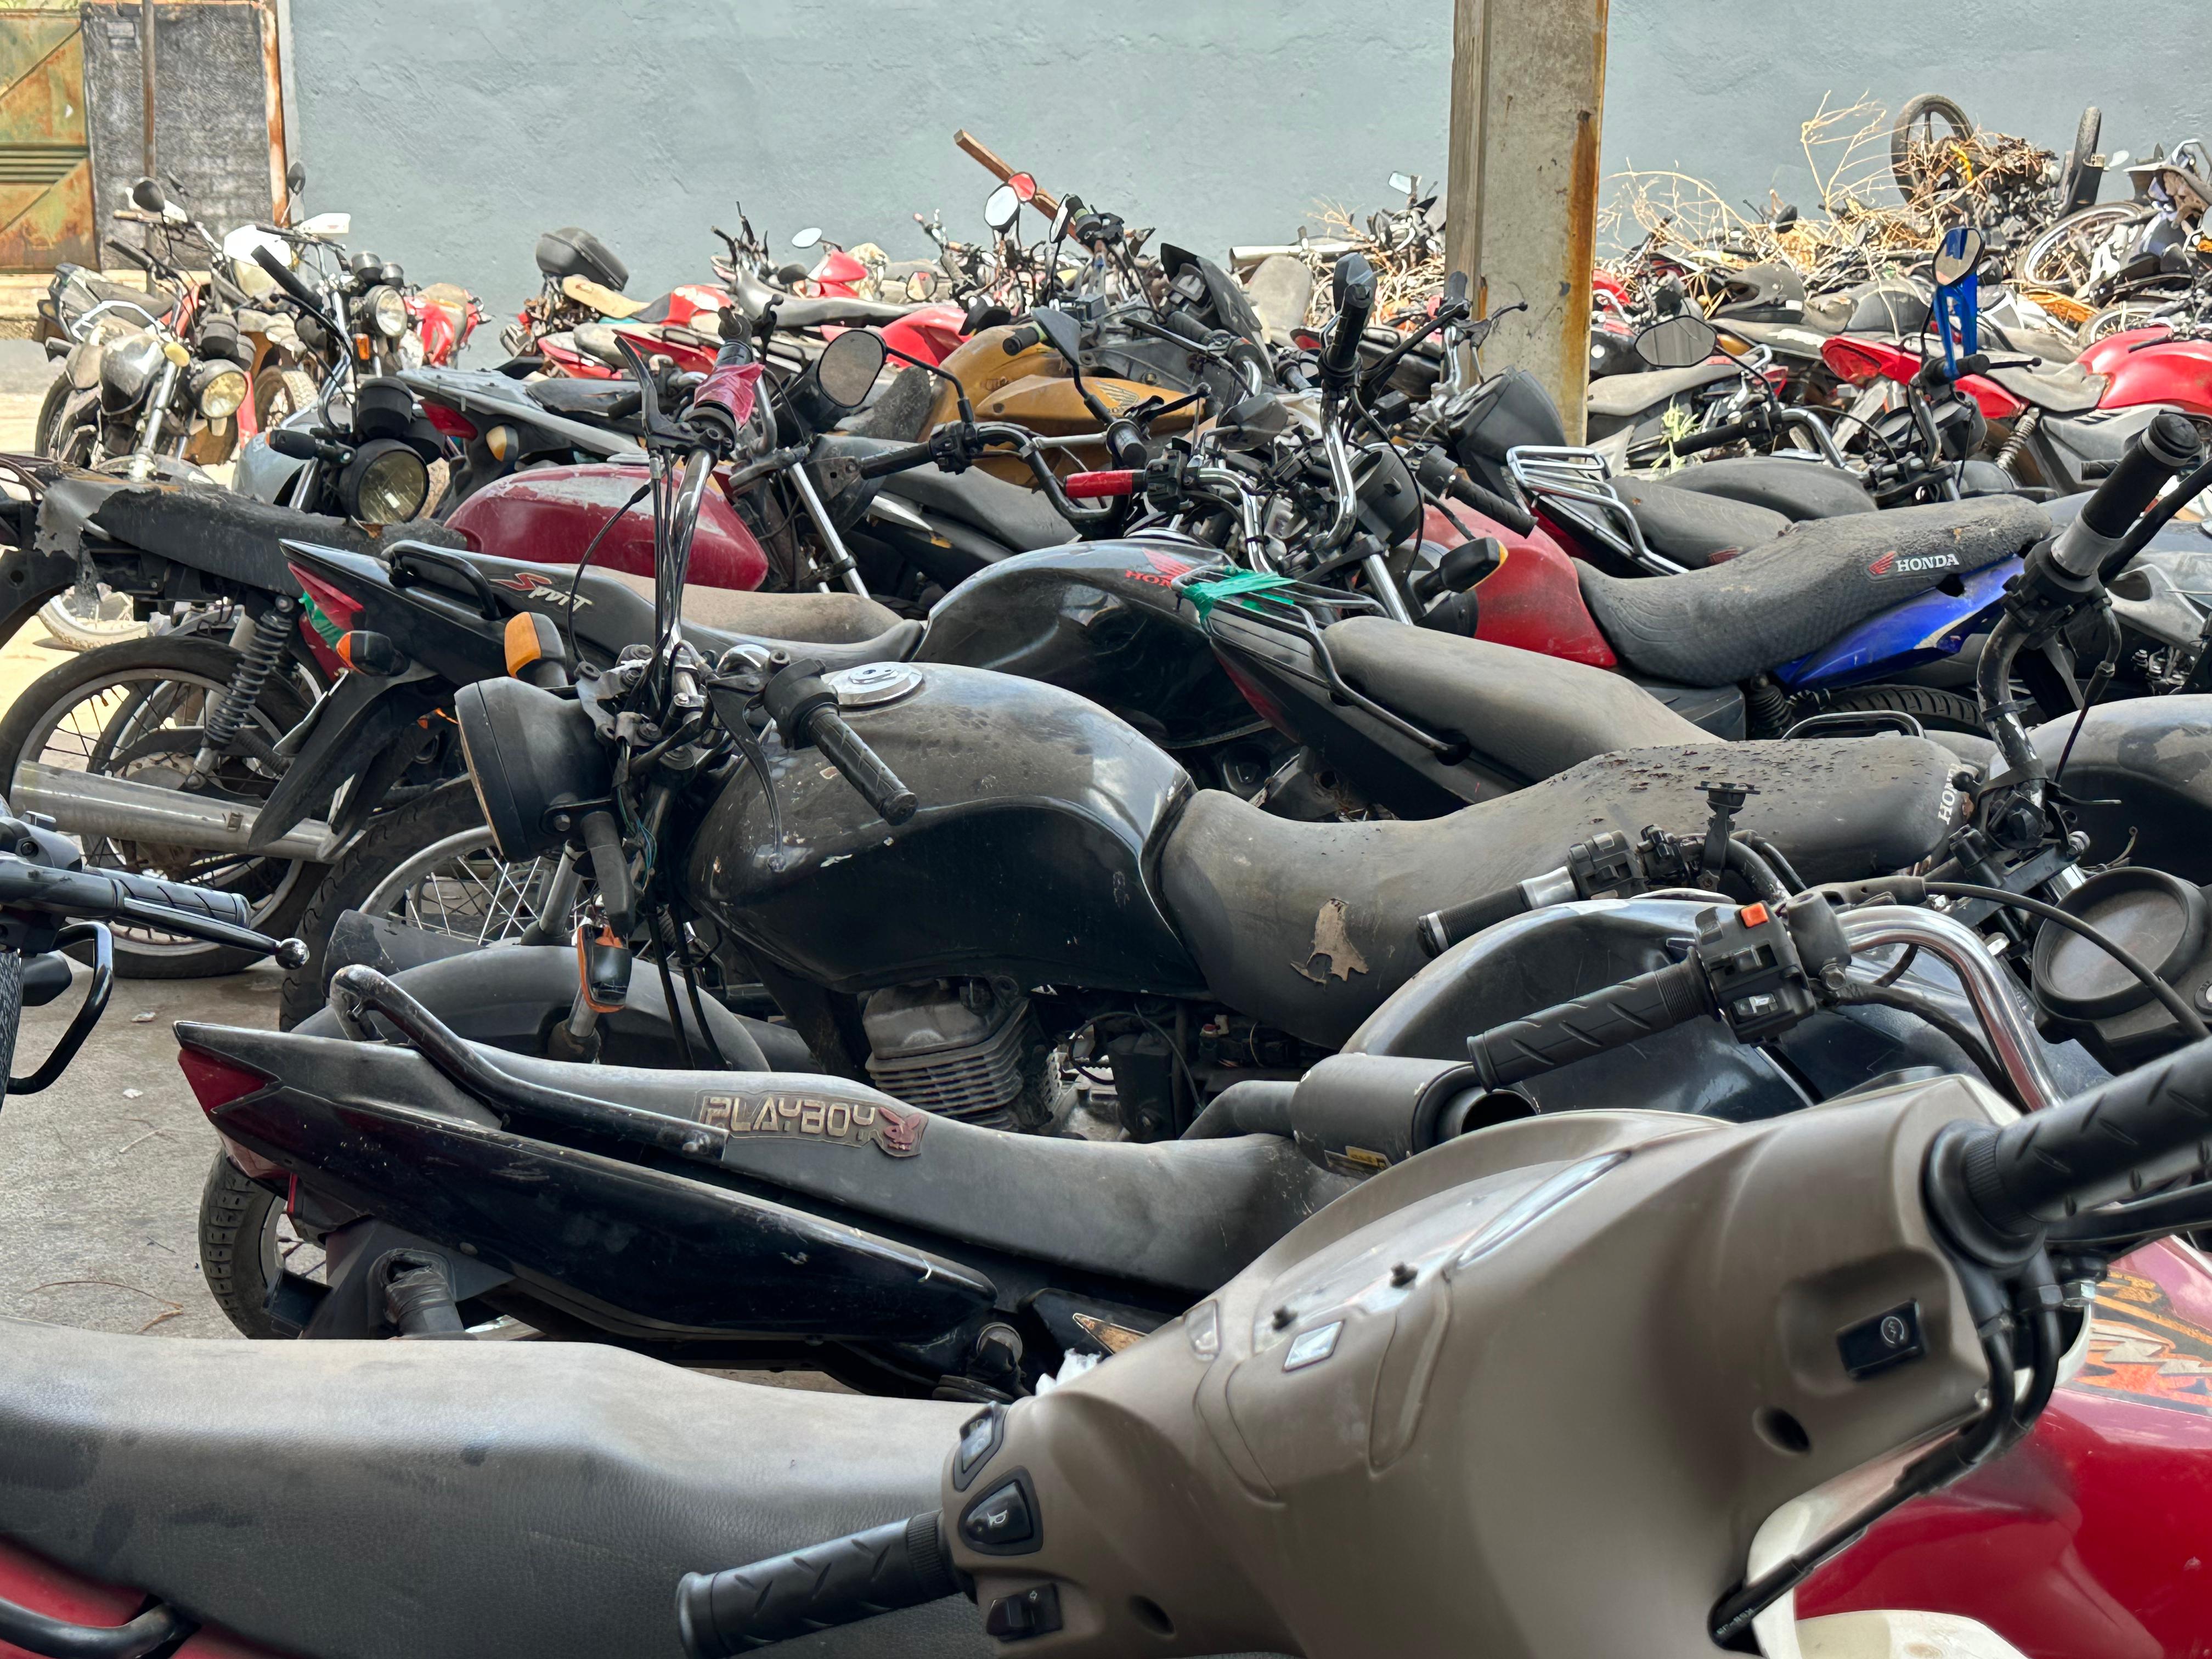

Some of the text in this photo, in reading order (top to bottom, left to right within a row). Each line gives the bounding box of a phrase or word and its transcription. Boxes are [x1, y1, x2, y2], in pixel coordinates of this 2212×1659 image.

[1895, 554, 1960, 572] HONDA
[1125, 569, 1172, 588] HON
[700, 1096, 876, 1141] PLAYBOY
